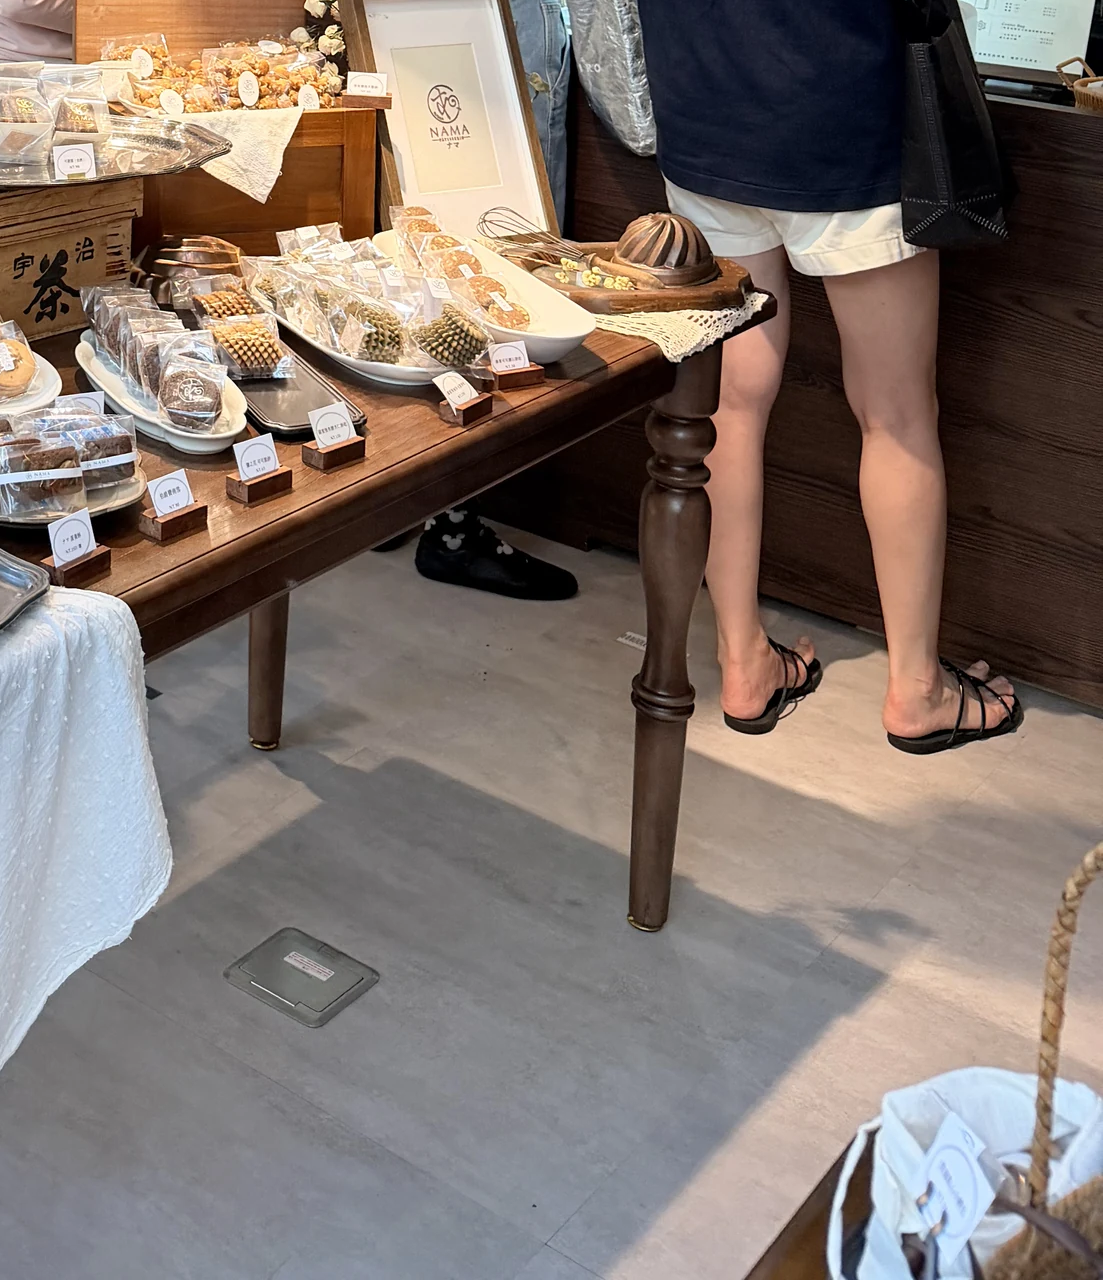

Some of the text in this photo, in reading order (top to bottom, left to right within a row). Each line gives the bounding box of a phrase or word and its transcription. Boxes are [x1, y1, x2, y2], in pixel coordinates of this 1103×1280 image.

[429, 123, 471, 139] NAMA
[12, 236, 95, 280] 宇 治
[22, 248, 81, 324] 茶
